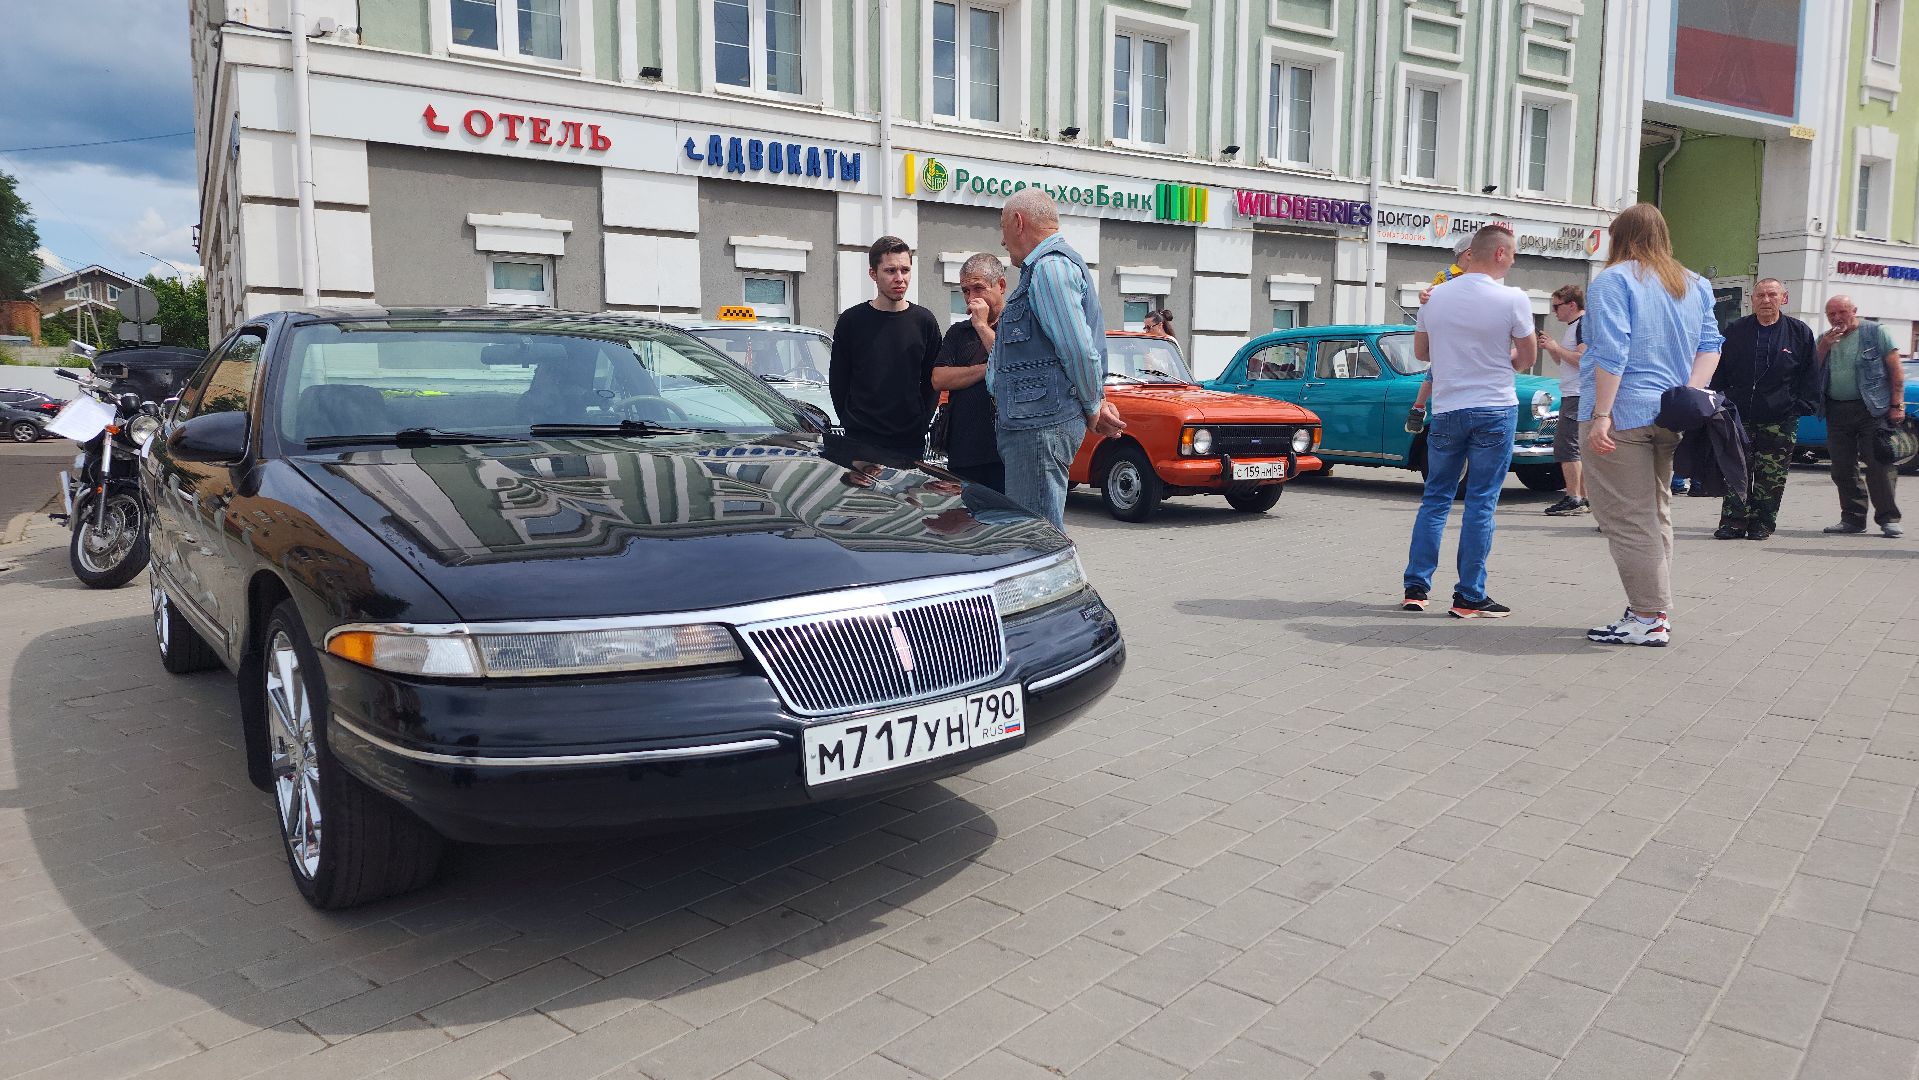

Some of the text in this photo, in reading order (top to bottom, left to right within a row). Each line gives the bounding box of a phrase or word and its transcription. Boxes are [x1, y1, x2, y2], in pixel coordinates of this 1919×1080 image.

[463, 109, 612, 152] ОТЕЛЬ
[708, 134, 862, 183] АДВОКАТЫ
[1236, 189, 1373, 227] WILDBERRIES
[1377, 209, 1486, 233] ДОКТОР ДЕНТ
[1376, 229, 1427, 242] ТОМАТОЛОГИЯ
[1520, 234, 1585, 252] документы
[817, 690, 1015, 776] М717УН 790
[981, 724, 1005, 740] RUS
